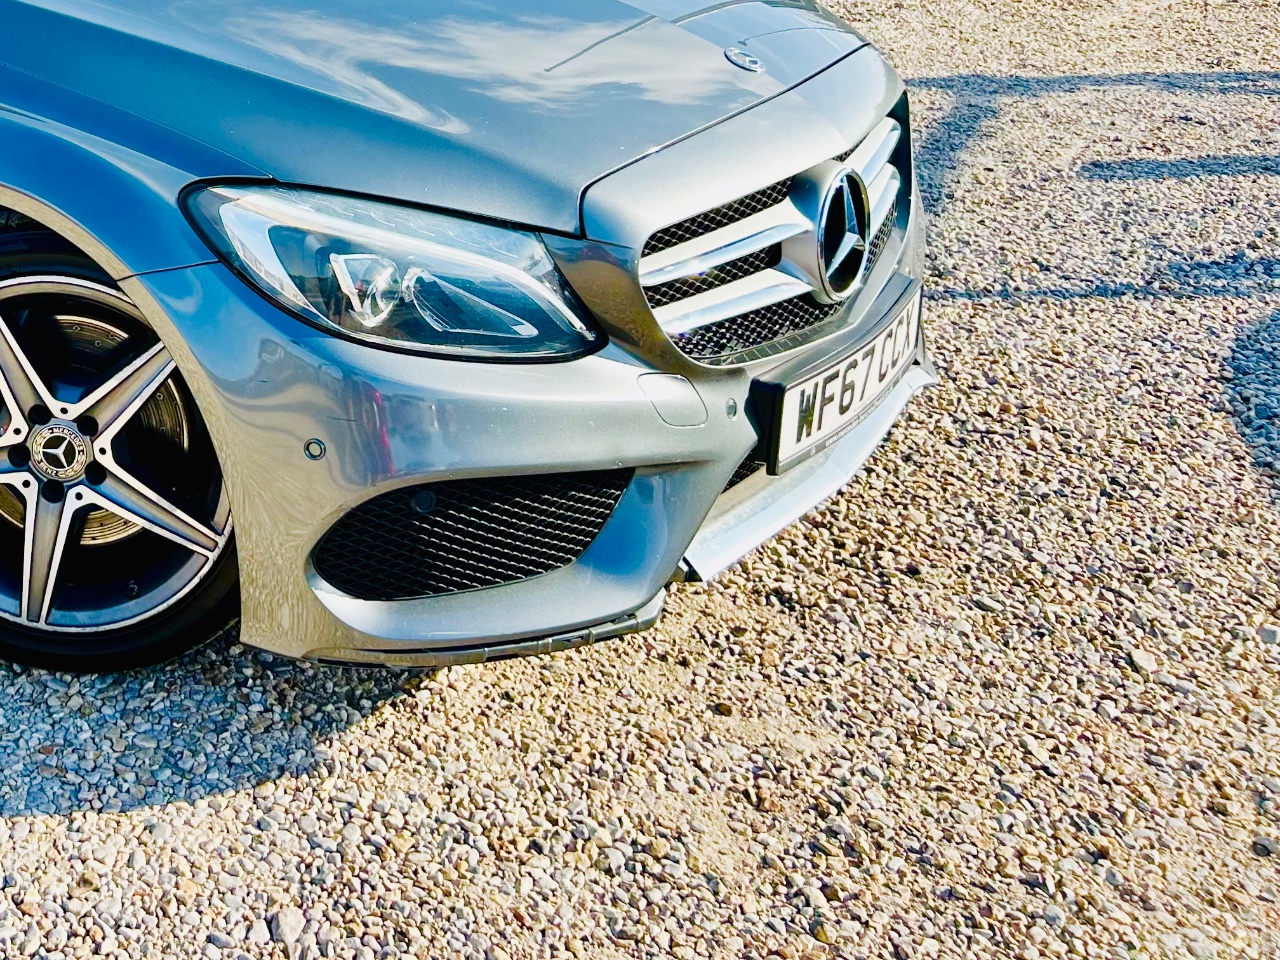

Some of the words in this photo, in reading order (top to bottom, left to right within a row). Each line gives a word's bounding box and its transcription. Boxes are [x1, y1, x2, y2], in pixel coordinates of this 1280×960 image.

[796, 343, 876, 444] WF67
[877, 299, 915, 384] CCX
[53, 427, 85, 451] MERCEDES
[39, 461, 58, 477] BENZ
